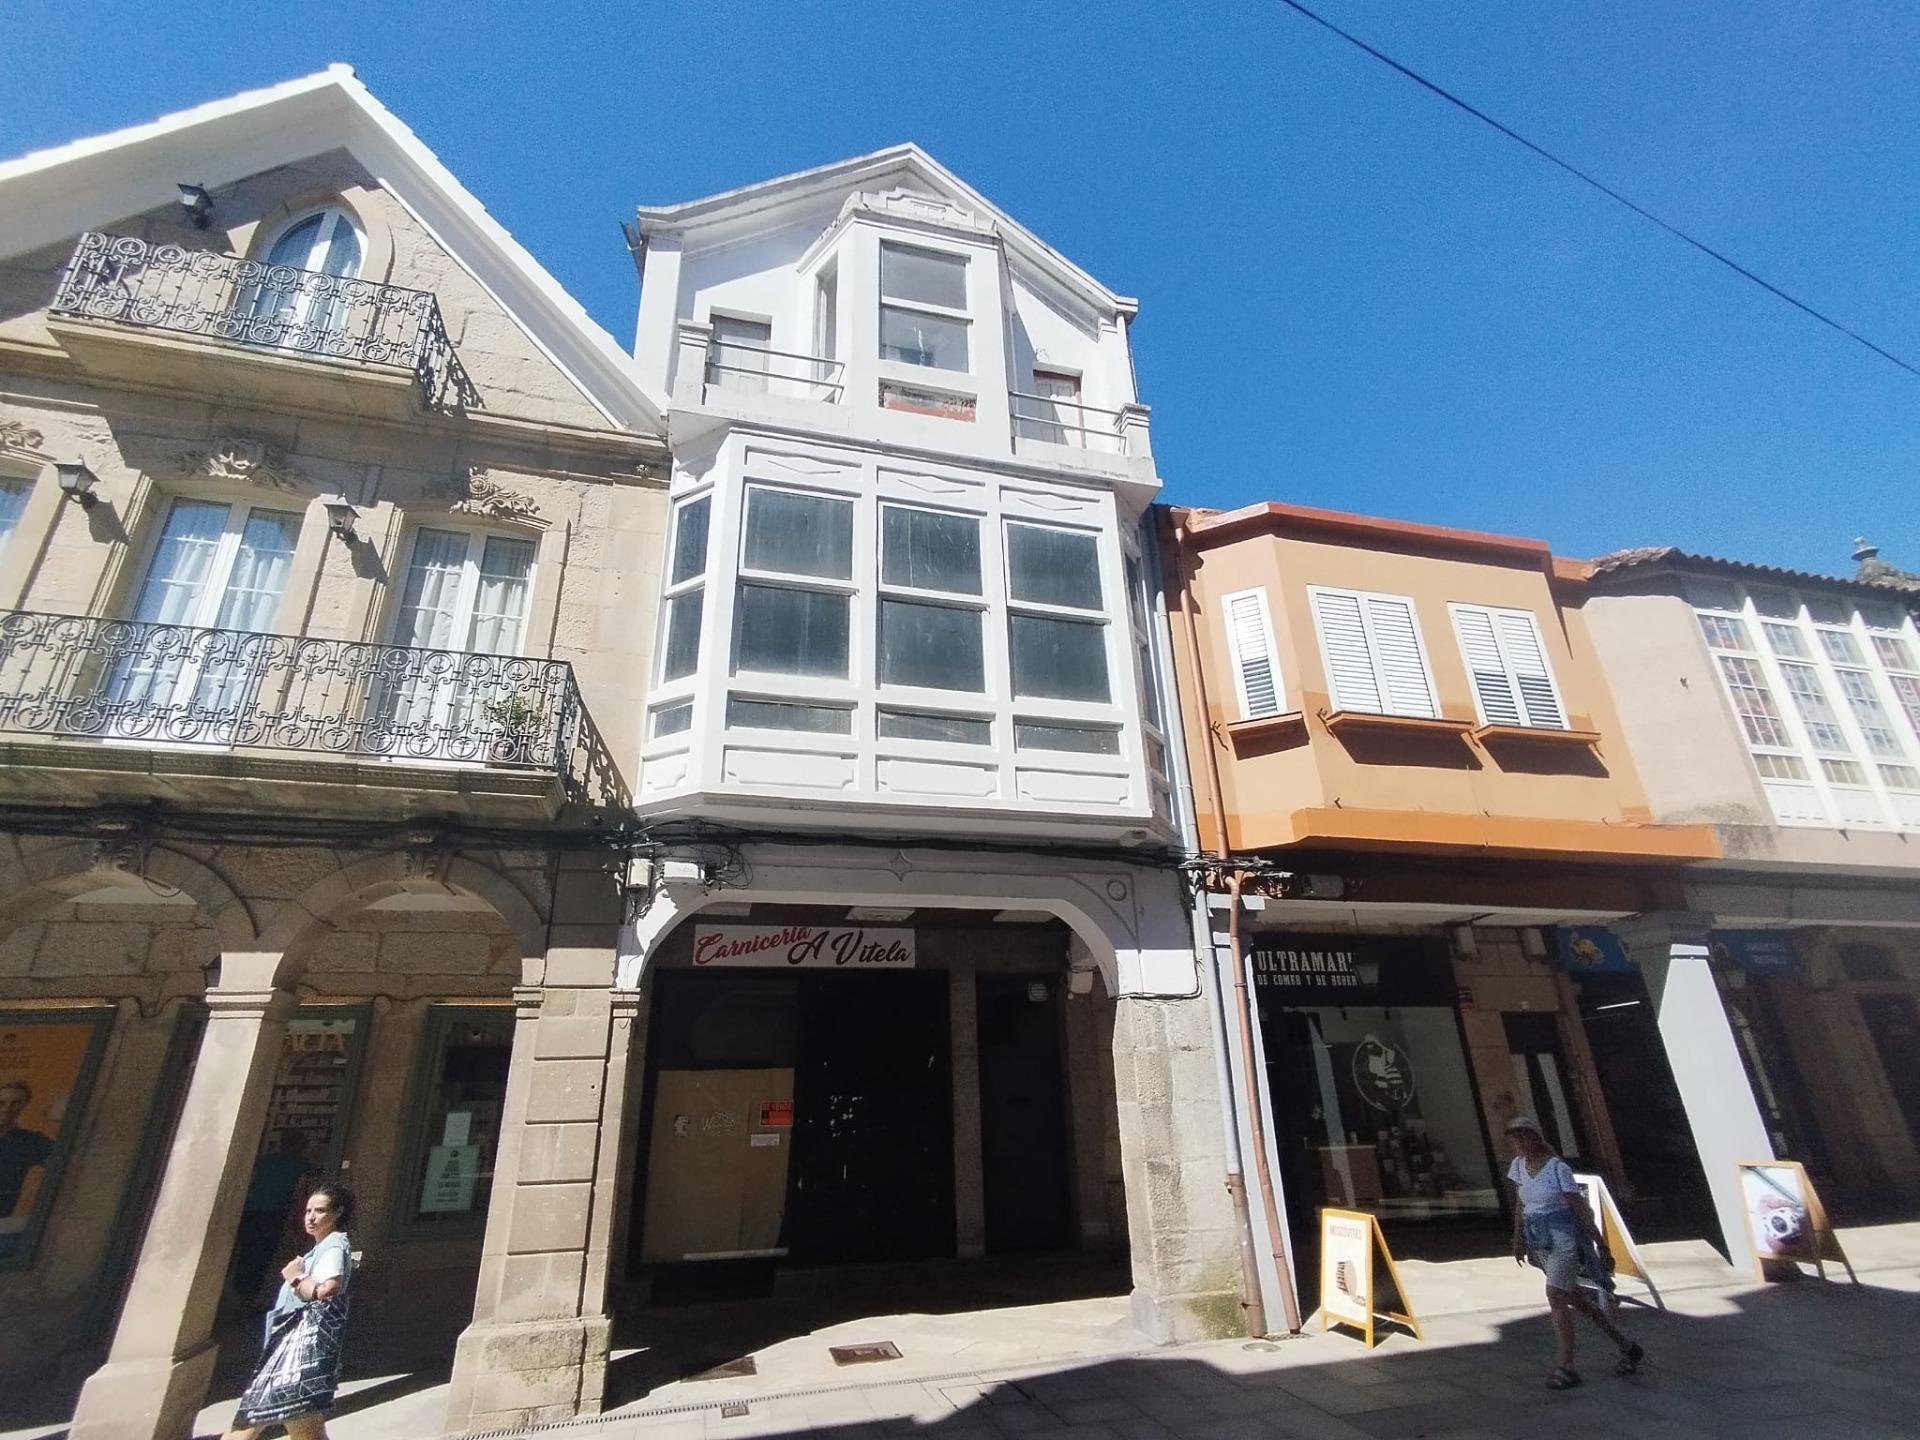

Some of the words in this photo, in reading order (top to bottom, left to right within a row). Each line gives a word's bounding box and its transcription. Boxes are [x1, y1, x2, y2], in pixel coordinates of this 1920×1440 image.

[787, 931, 830, 965] A
[831, 929, 911, 965] Vitela
[1257, 975, 1268, 985] DE
[1306, 975, 1311, 986] Y
[1315, 975, 1327, 986] DE
